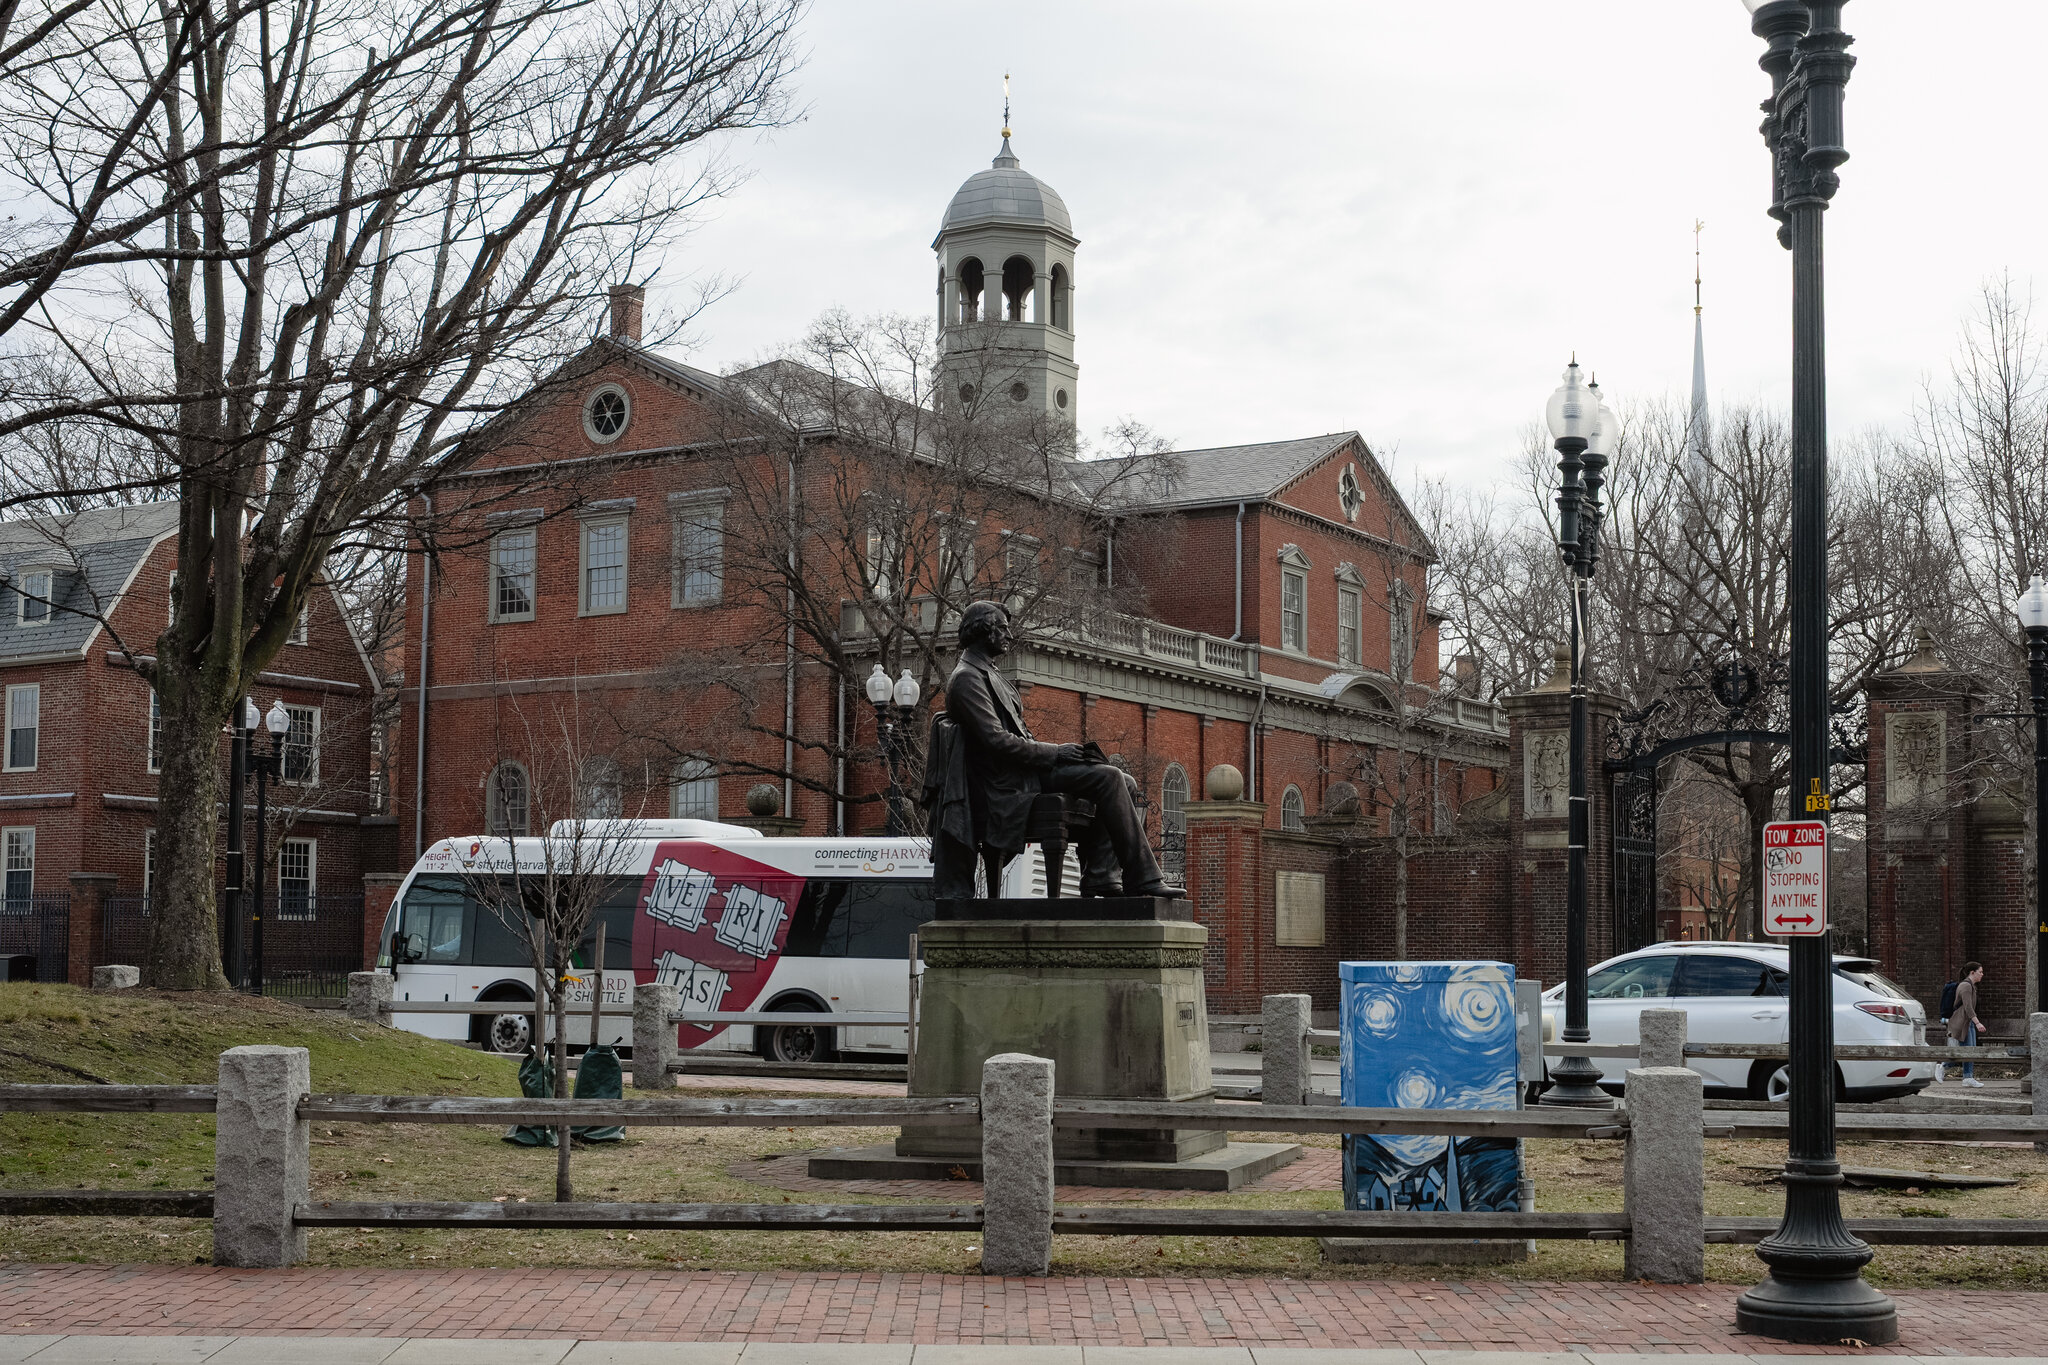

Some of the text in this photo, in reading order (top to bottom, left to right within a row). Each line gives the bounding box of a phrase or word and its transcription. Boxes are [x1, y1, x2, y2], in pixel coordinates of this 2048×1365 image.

[1766, 828, 1823, 844] TOW ZONE
[815, 847, 932, 862] connecting HARVA
[1785, 851, 1802, 865] NO
[1770, 872, 1820, 886] STOPPING
[664, 874, 697, 908] VE
[1771, 893, 1818, 908] ANYTIME
[732, 901, 765, 934] RI
[671, 966, 711, 1004] TAS
